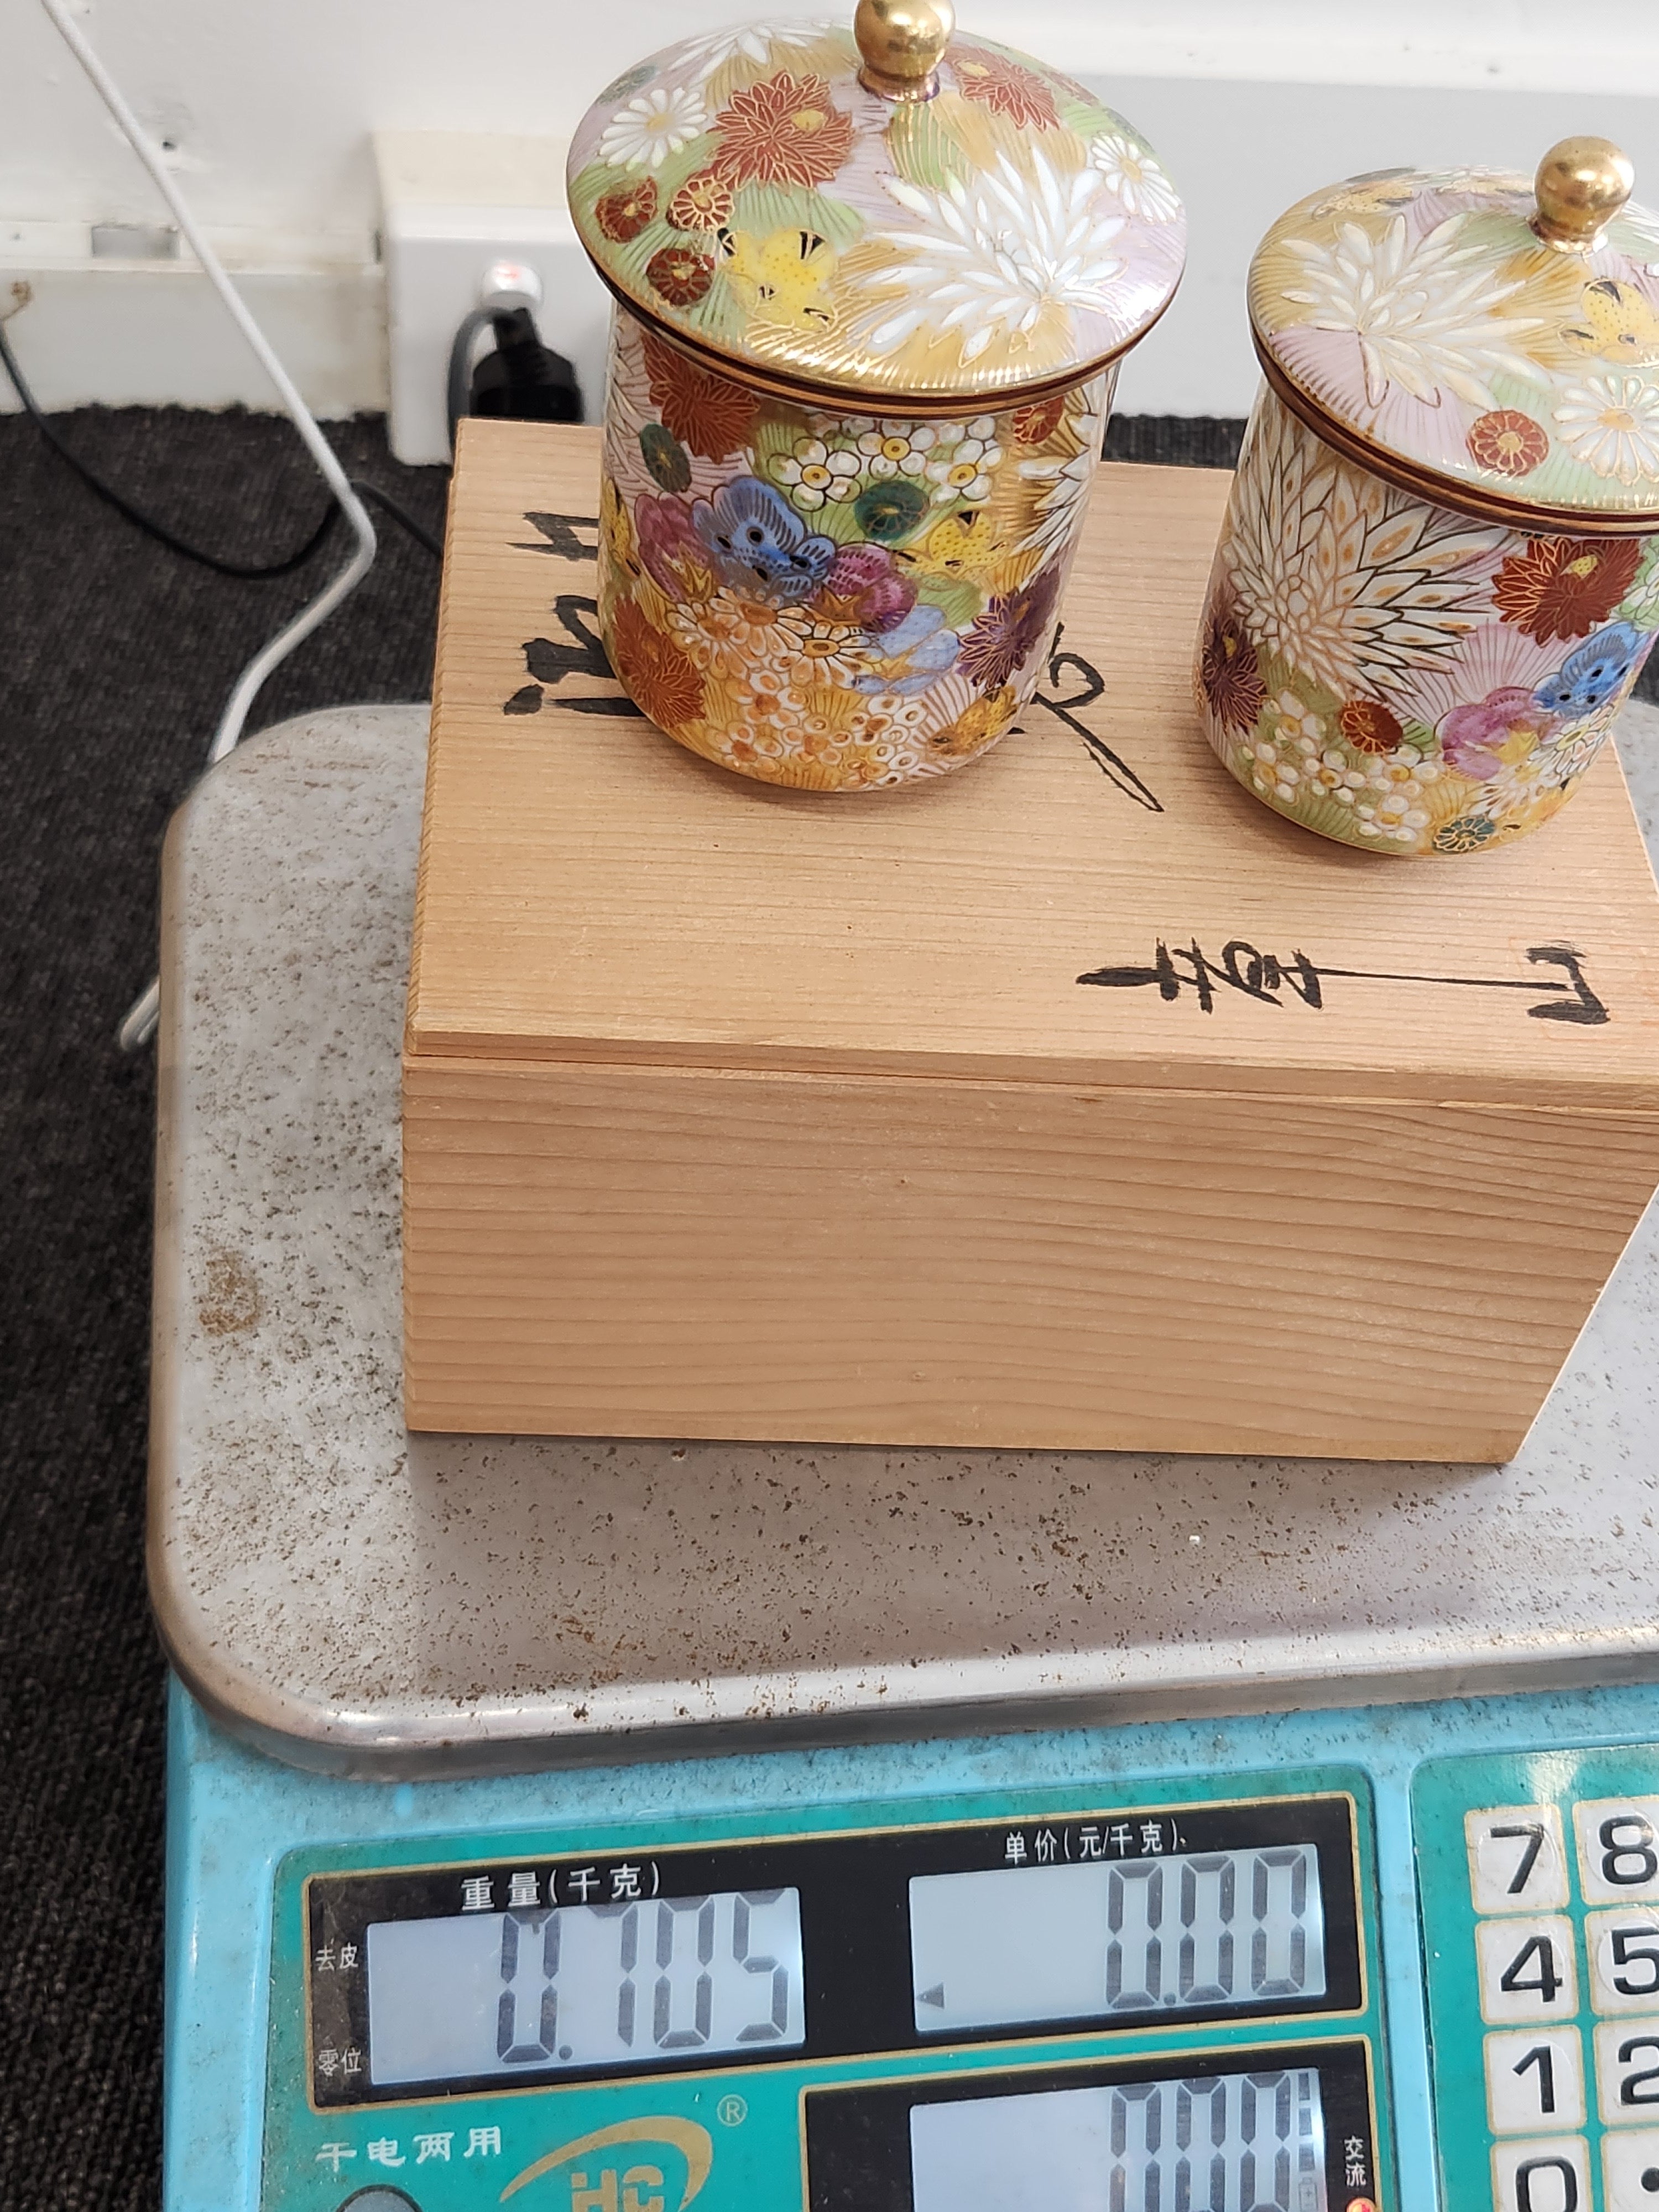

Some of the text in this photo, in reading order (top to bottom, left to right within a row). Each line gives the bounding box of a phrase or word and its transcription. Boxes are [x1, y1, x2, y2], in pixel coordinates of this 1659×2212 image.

[1490, 1824, 1545, 1893] 7
[1599, 1815, 1658, 1885] 8
[315, 1942, 359, 1972] 去皮
[1107, 1849, 1306, 2010] 0.00
[1611, 1927, 1659, 1995] 5
[497, 1888, 790, 2064] 0.705
[1501, 1936, 1563, 2002] 4
[319, 2048, 362, 2077] 零位
[1512, 2046, 1555, 2113] 1
[1619, 2036, 1659, 2106] 2
[315, 2126, 501, 2173] 干电两用
[1344, 2135, 1367, 2187] 交流
[1516, 2156, 1578, 2212] 0
